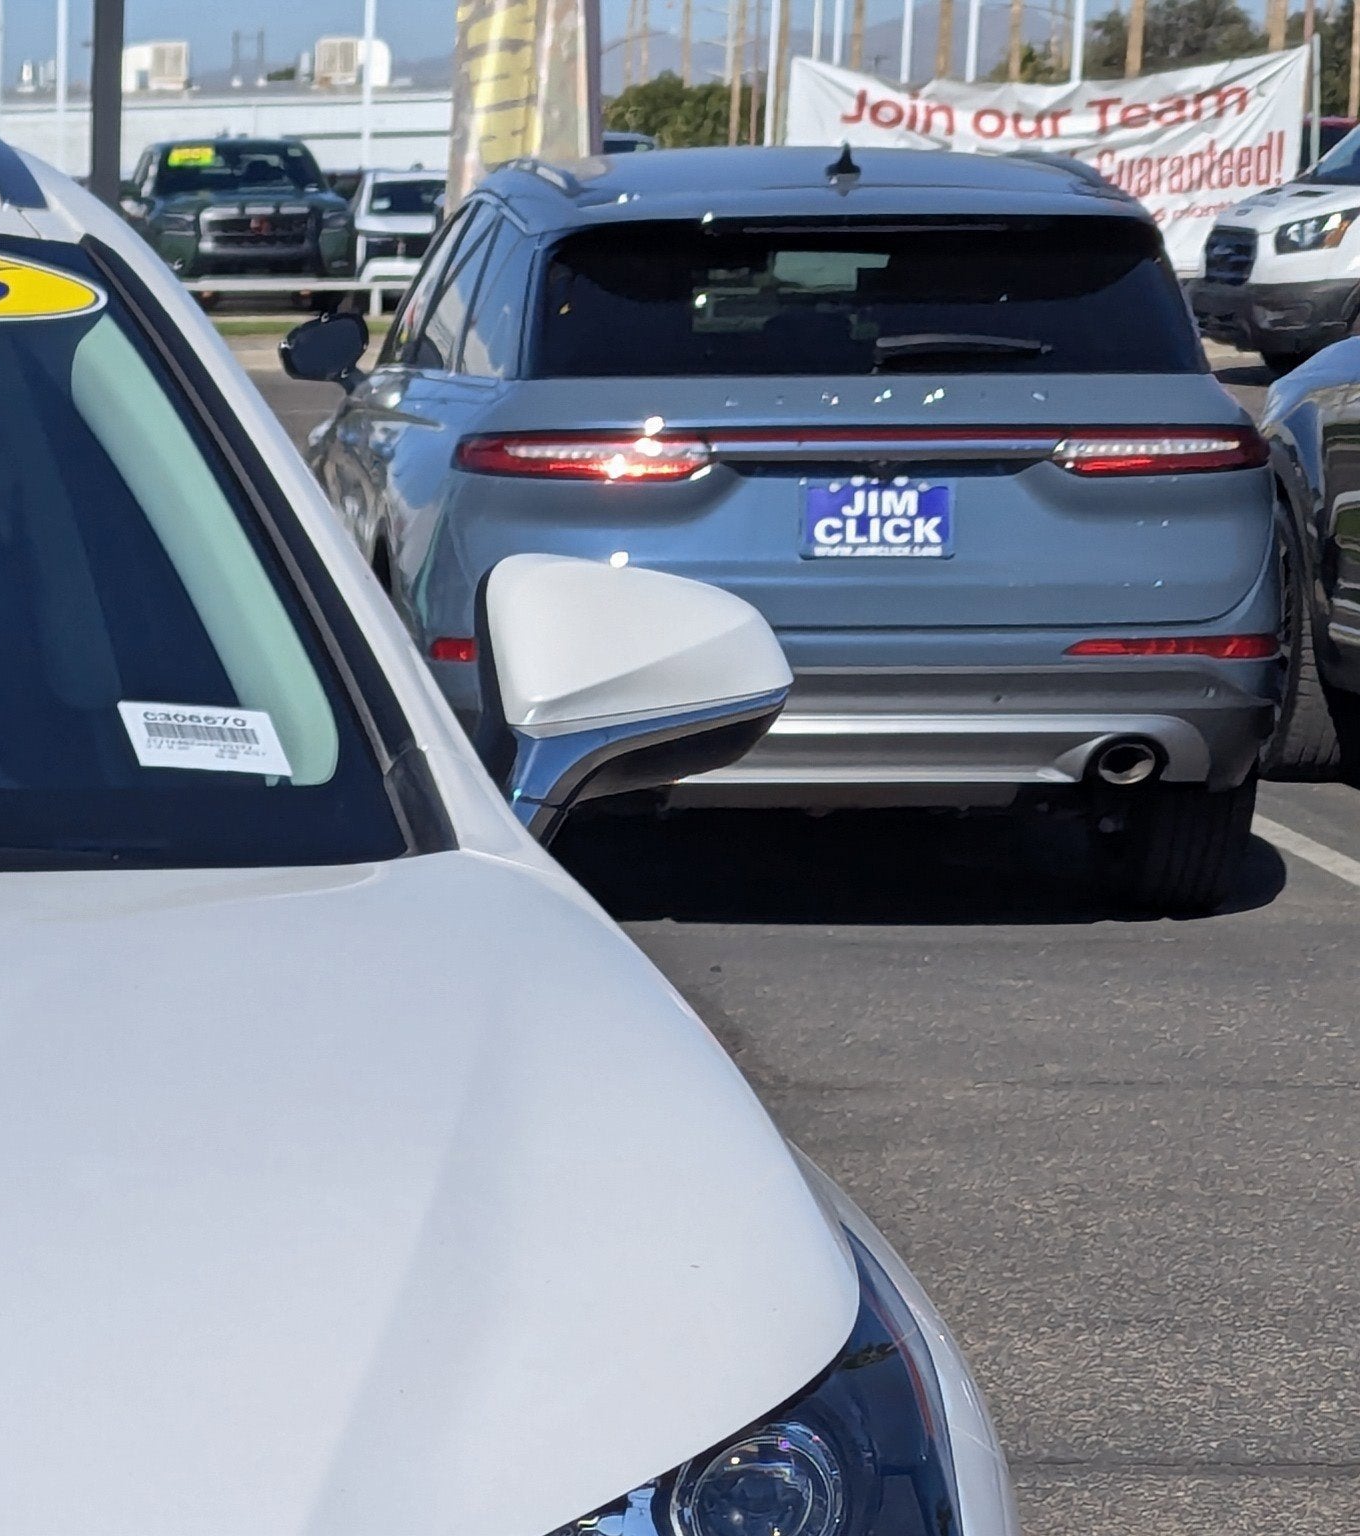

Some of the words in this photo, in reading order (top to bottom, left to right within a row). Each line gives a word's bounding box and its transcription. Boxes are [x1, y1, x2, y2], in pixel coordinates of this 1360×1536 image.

[841, 88, 956, 137] Join
[972, 104, 1072, 140] our
[1086, 84, 1250, 135] Team
[840, 489, 920, 518] JIM
[813, 516, 943, 545] CLICK
